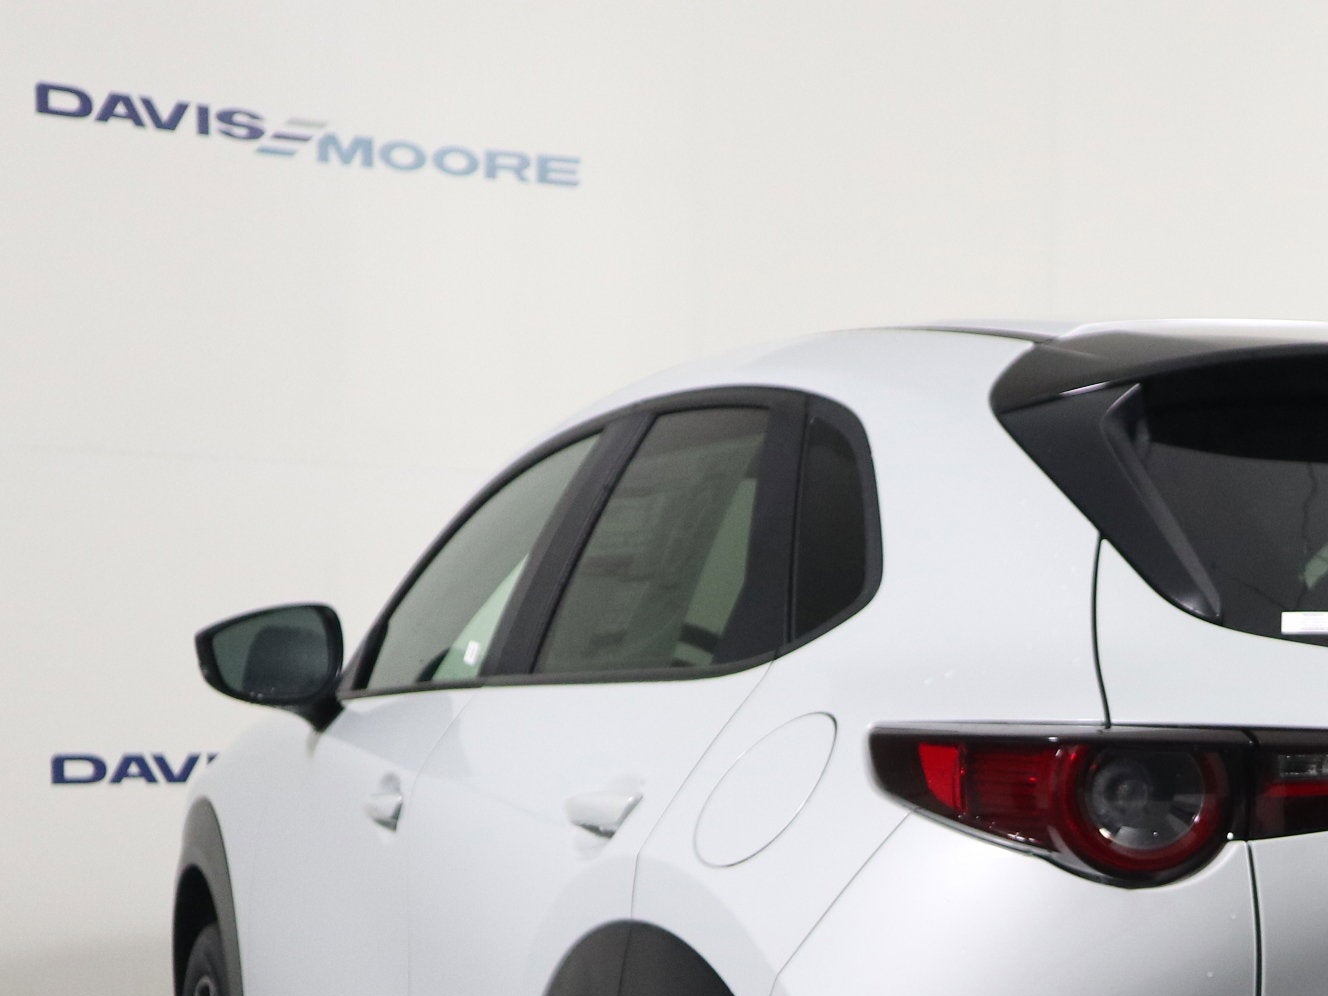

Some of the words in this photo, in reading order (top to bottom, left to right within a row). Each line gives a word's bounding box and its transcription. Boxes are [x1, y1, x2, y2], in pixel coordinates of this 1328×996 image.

[34, 81, 266, 141] DAVIS
[316, 132, 582, 187] MOORE
[51, 752, 218, 784] DAV
